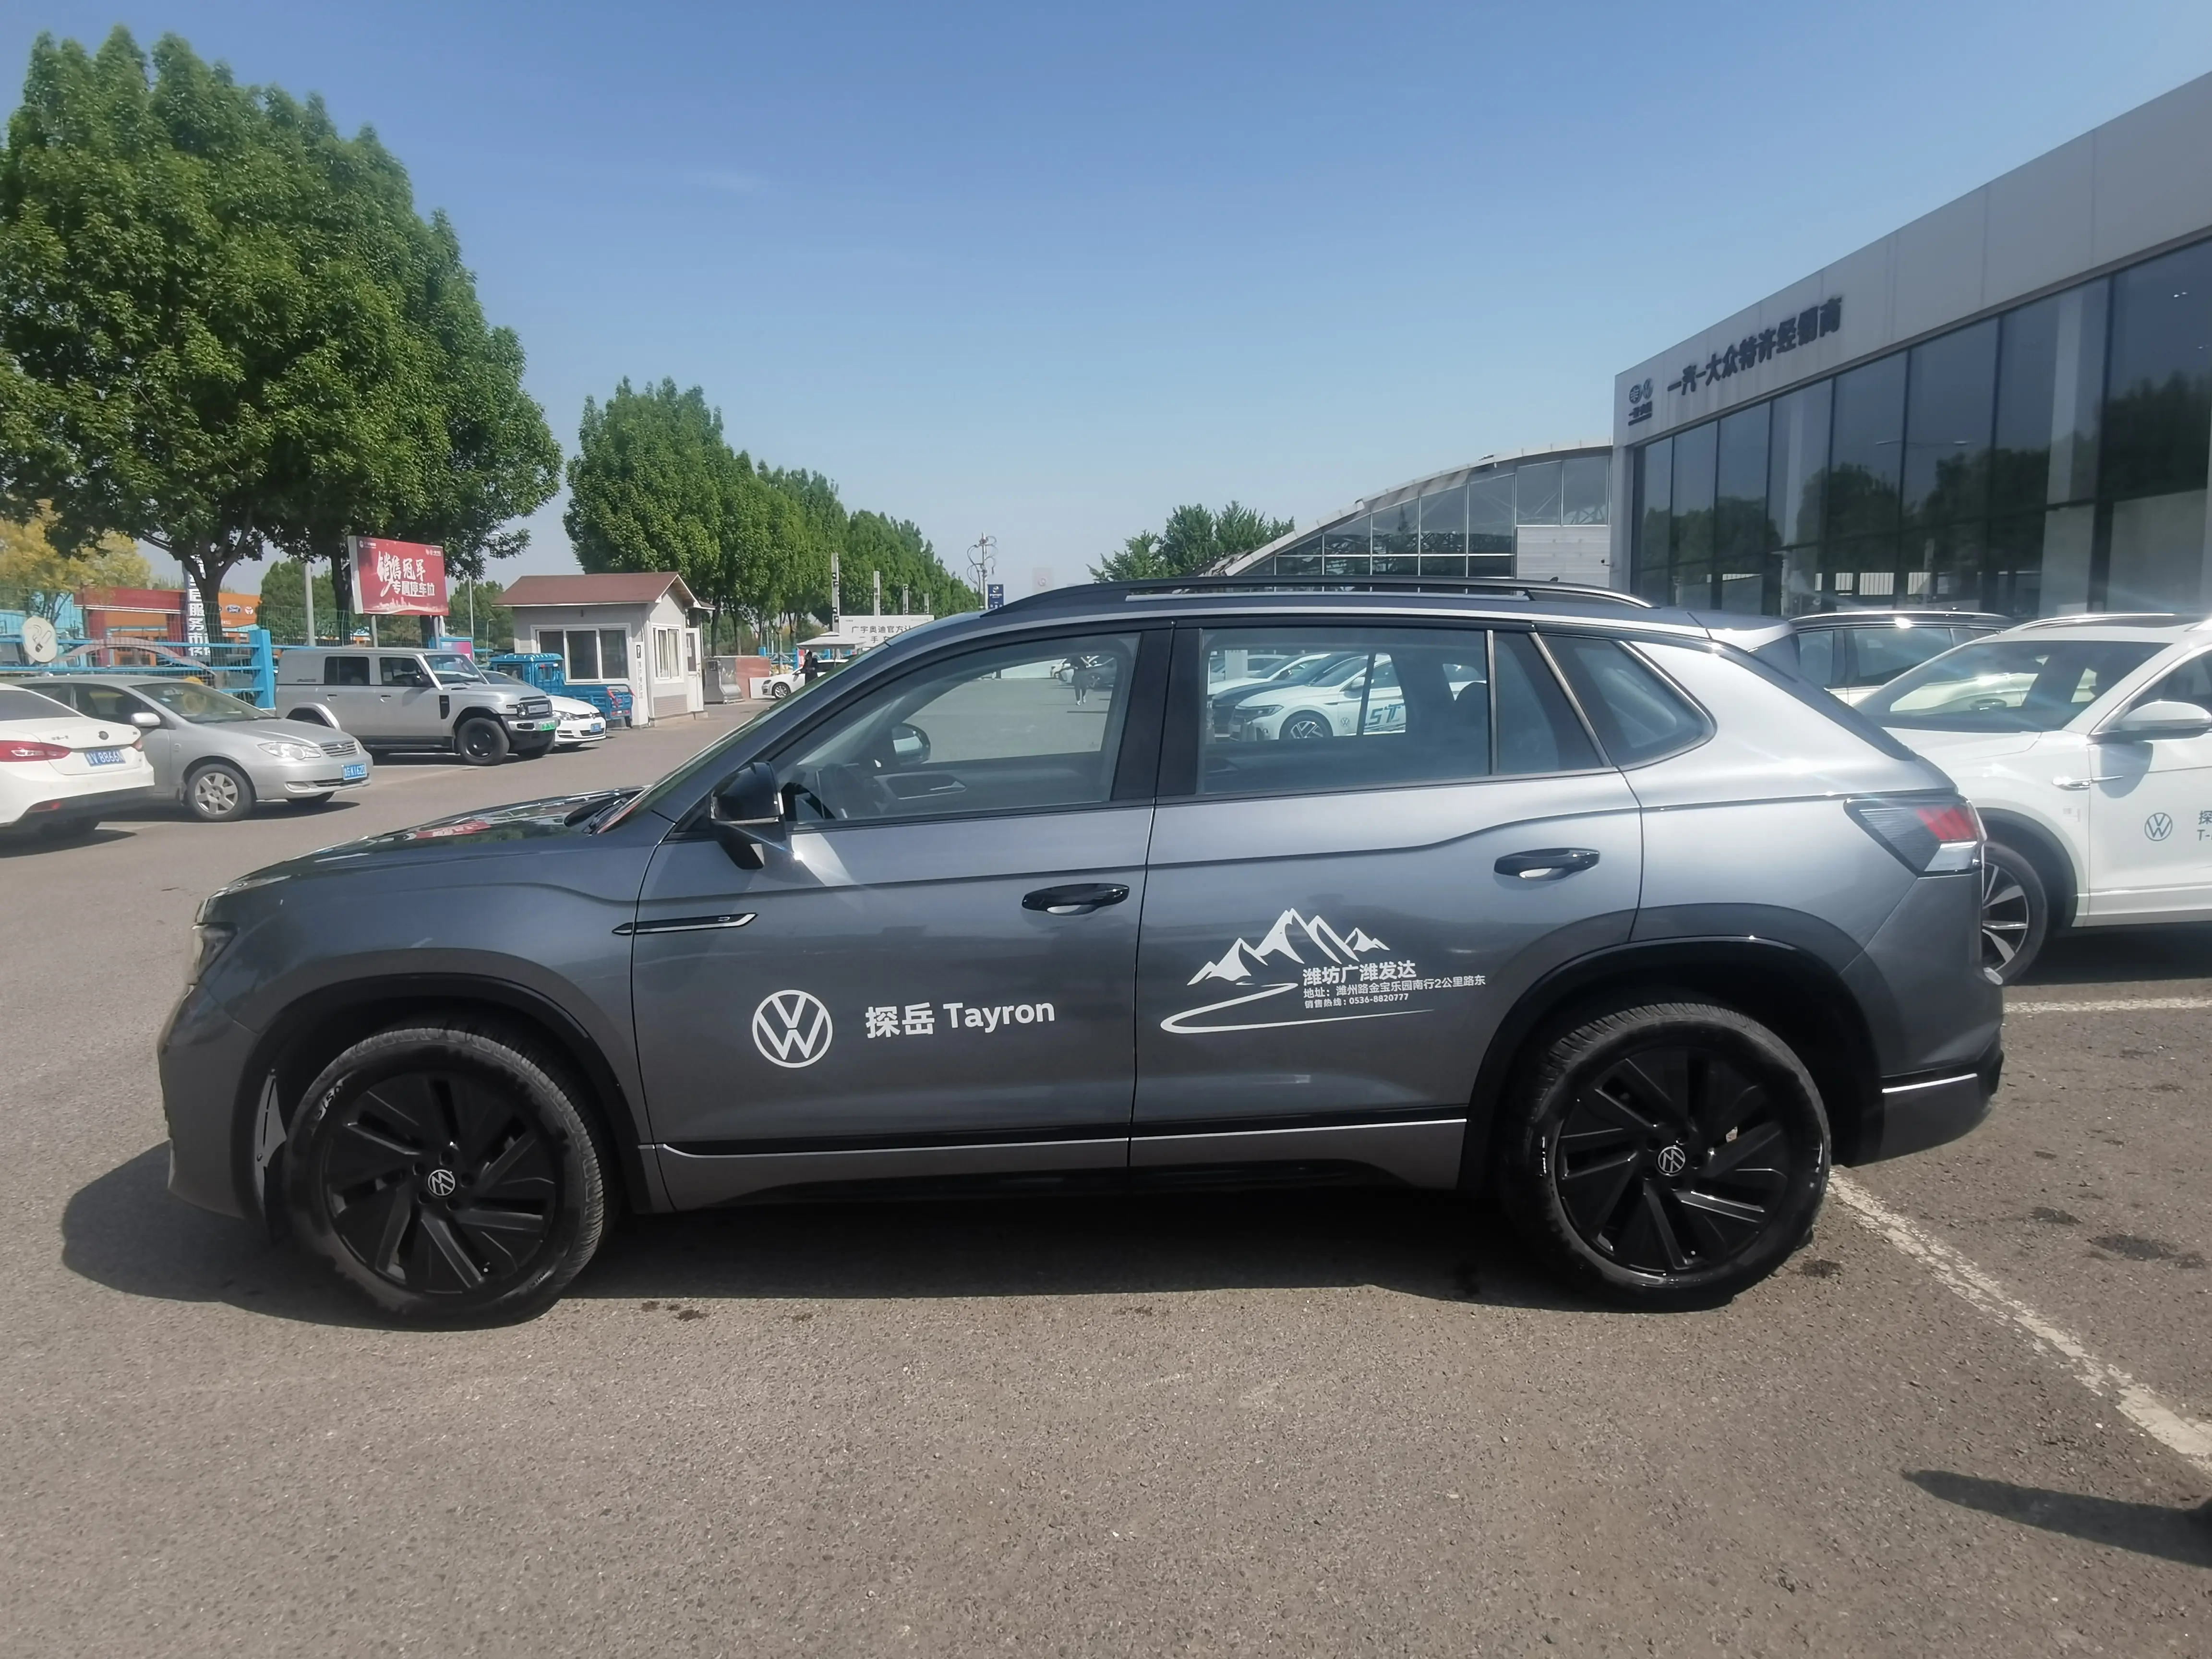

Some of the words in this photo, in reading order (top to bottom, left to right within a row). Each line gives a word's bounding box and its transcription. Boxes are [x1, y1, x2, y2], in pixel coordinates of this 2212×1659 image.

[2197, 830, 2212, 841] T-
[1303, 960, 1416, 986] 潍坊广潍发达
[866, 1003, 935, 1038] 探岳
[943, 1002, 1055, 1033] Tayron
